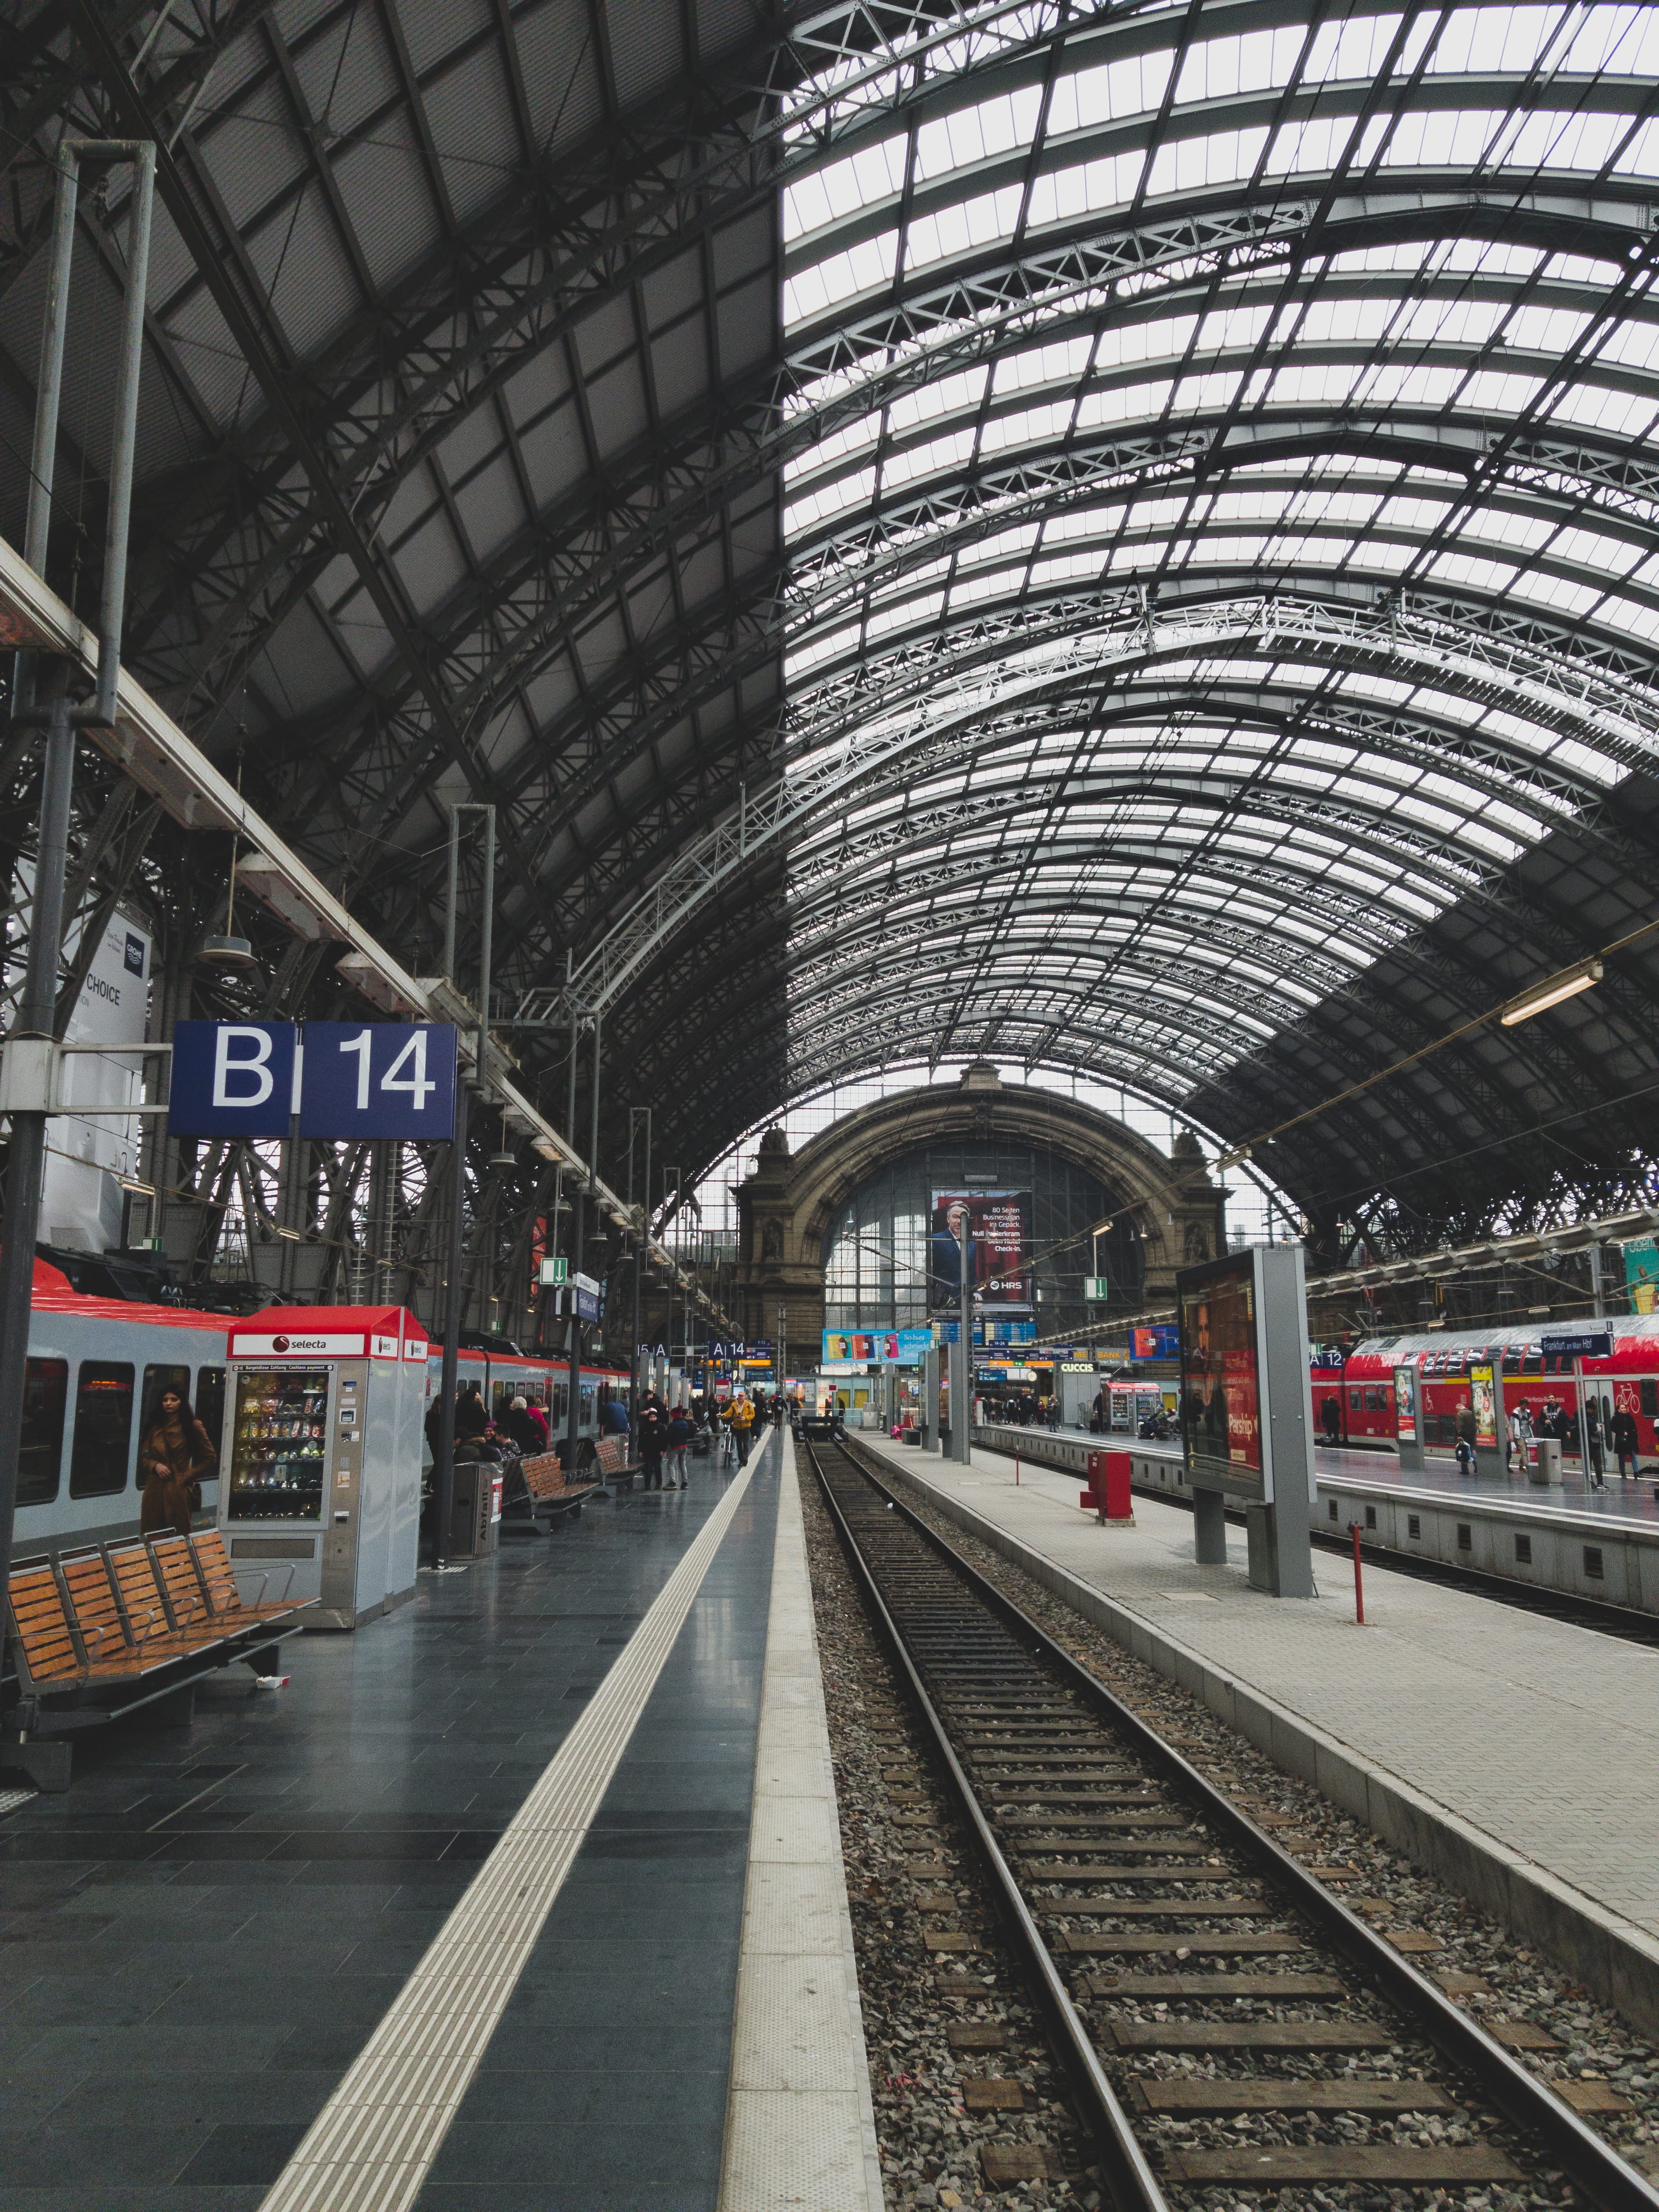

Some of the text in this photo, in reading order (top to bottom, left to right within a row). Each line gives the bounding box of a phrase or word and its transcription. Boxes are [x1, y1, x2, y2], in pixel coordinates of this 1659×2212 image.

[127, 944, 142, 959] GROHE
[87, 973, 120, 1006] CHOICE
[212, 1026, 436, 1109] B 14
[291, 1340, 326, 1349] selecta
[656, 1344, 666, 1357] A
[713, 1342, 744, 1356] A 14
[1543, 1340, 1566, 1351] Frankfurt
[1582, 1338, 1593, 1349] Hbf
[1310, 1353, 1342, 1365] A 12
[1060, 1363, 1093, 1372] CUCCIS
[1228, 1413, 1252, 1442] Parship
[480, 1492, 488, 1541] Abfall
